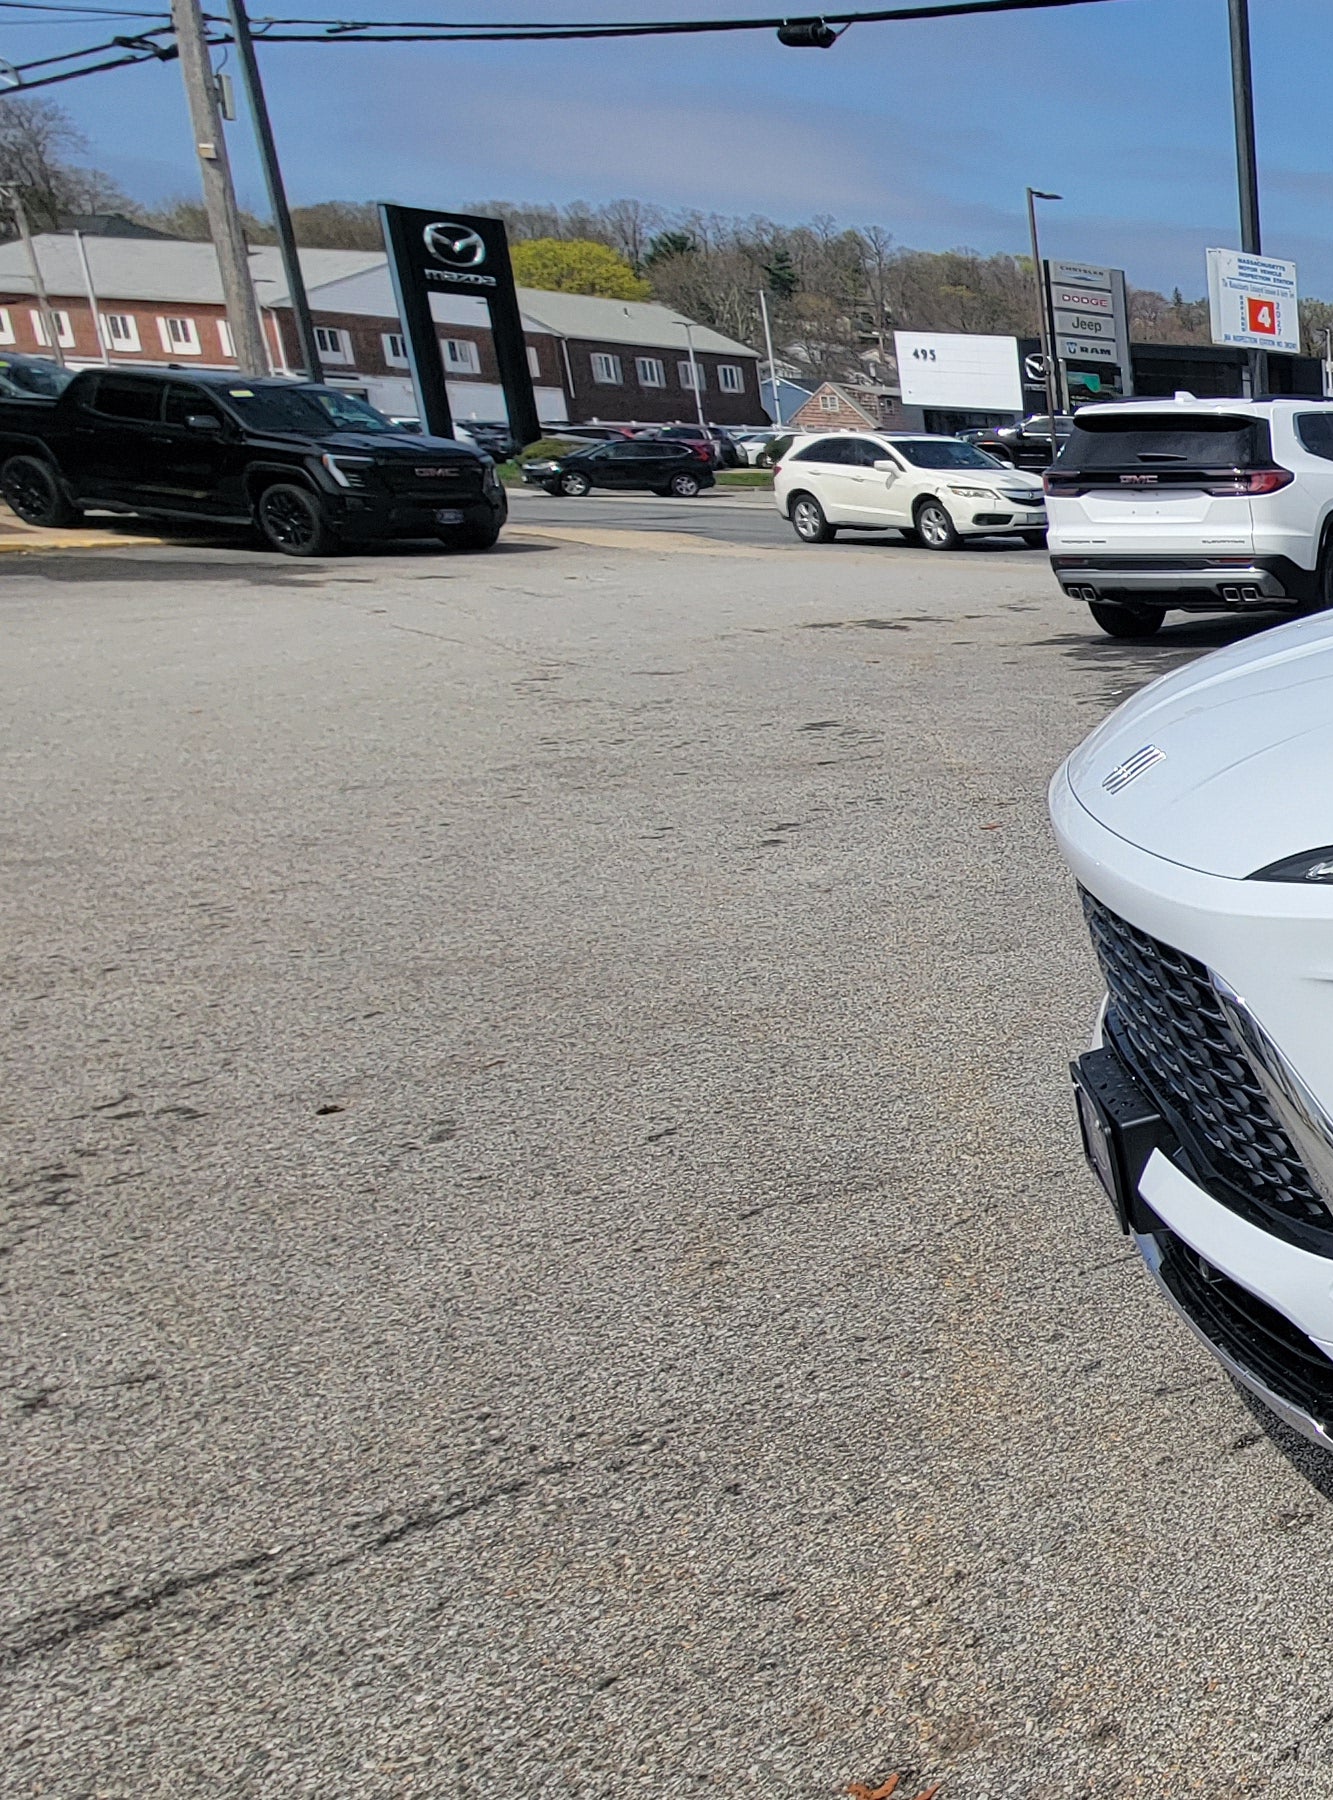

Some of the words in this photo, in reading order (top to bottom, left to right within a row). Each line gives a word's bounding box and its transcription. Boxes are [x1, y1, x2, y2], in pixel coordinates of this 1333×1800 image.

[1060, 265, 1104, 276] CHRYSLER
[1237, 258, 1286, 272] MASSACHUSETTS
[1238, 271, 1271, 282] INSPECTION
[1273, 277, 1294, 286] STATION
[1260, 268, 1282, 277] VEHICLE
[1062, 294, 1108, 307] DODGE
[1257, 306, 1271, 328] 4
[1072, 316, 1102, 334] Jeep
[912, 348, 936, 361] 495
[1079, 346, 1112, 356] RAM
[414, 467, 460, 477] GMC
[1119, 475, 1159, 484] GMC
